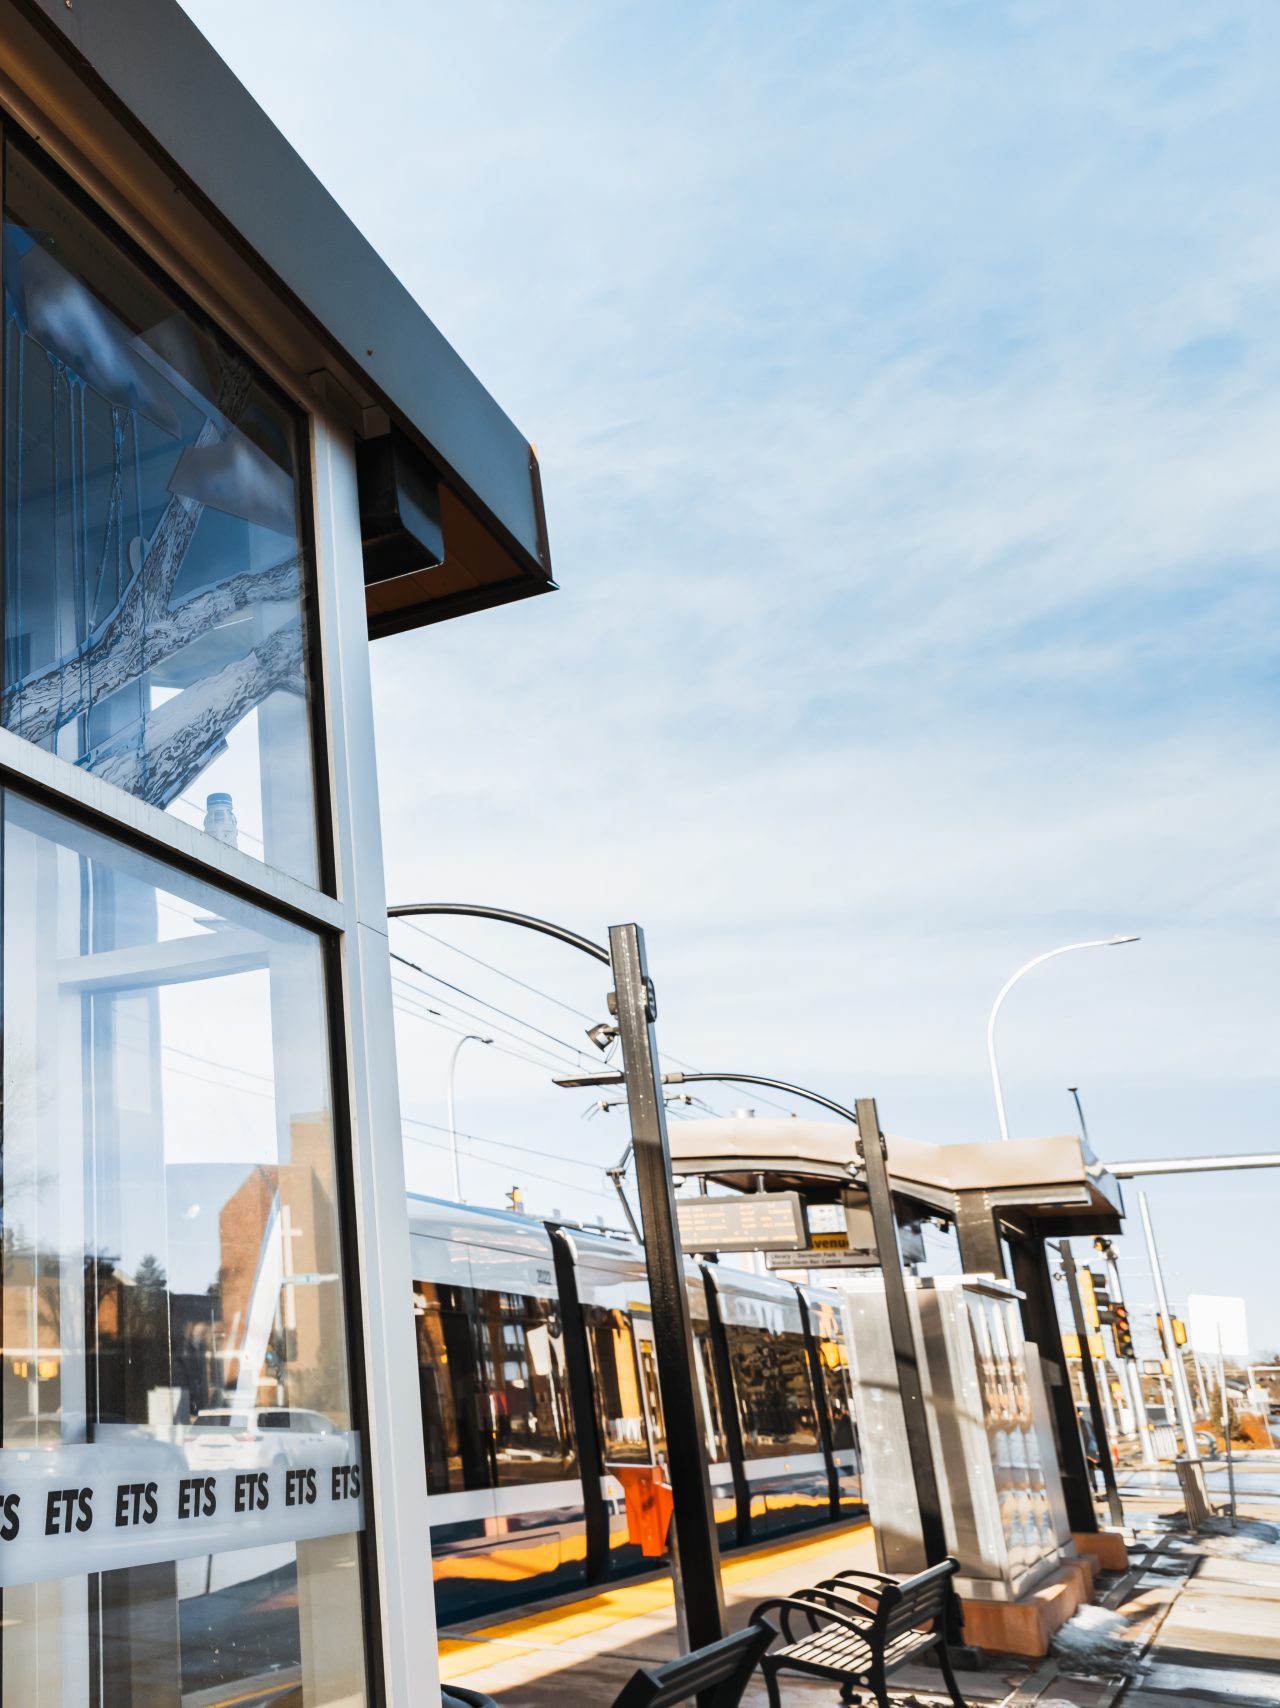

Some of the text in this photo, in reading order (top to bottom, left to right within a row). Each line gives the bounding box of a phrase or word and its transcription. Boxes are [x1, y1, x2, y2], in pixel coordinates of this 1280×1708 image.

[811, 1237, 849, 1250] venu
[45, 1487, 93, 1536] ETS
[115, 1481, 158, 1527] ETS
[178, 1476, 217, 1520] ETS
[234, 1471, 269, 1513] ETS
[285, 1467, 317, 1505] ETS
[331, 1464, 360, 1501] ETS
